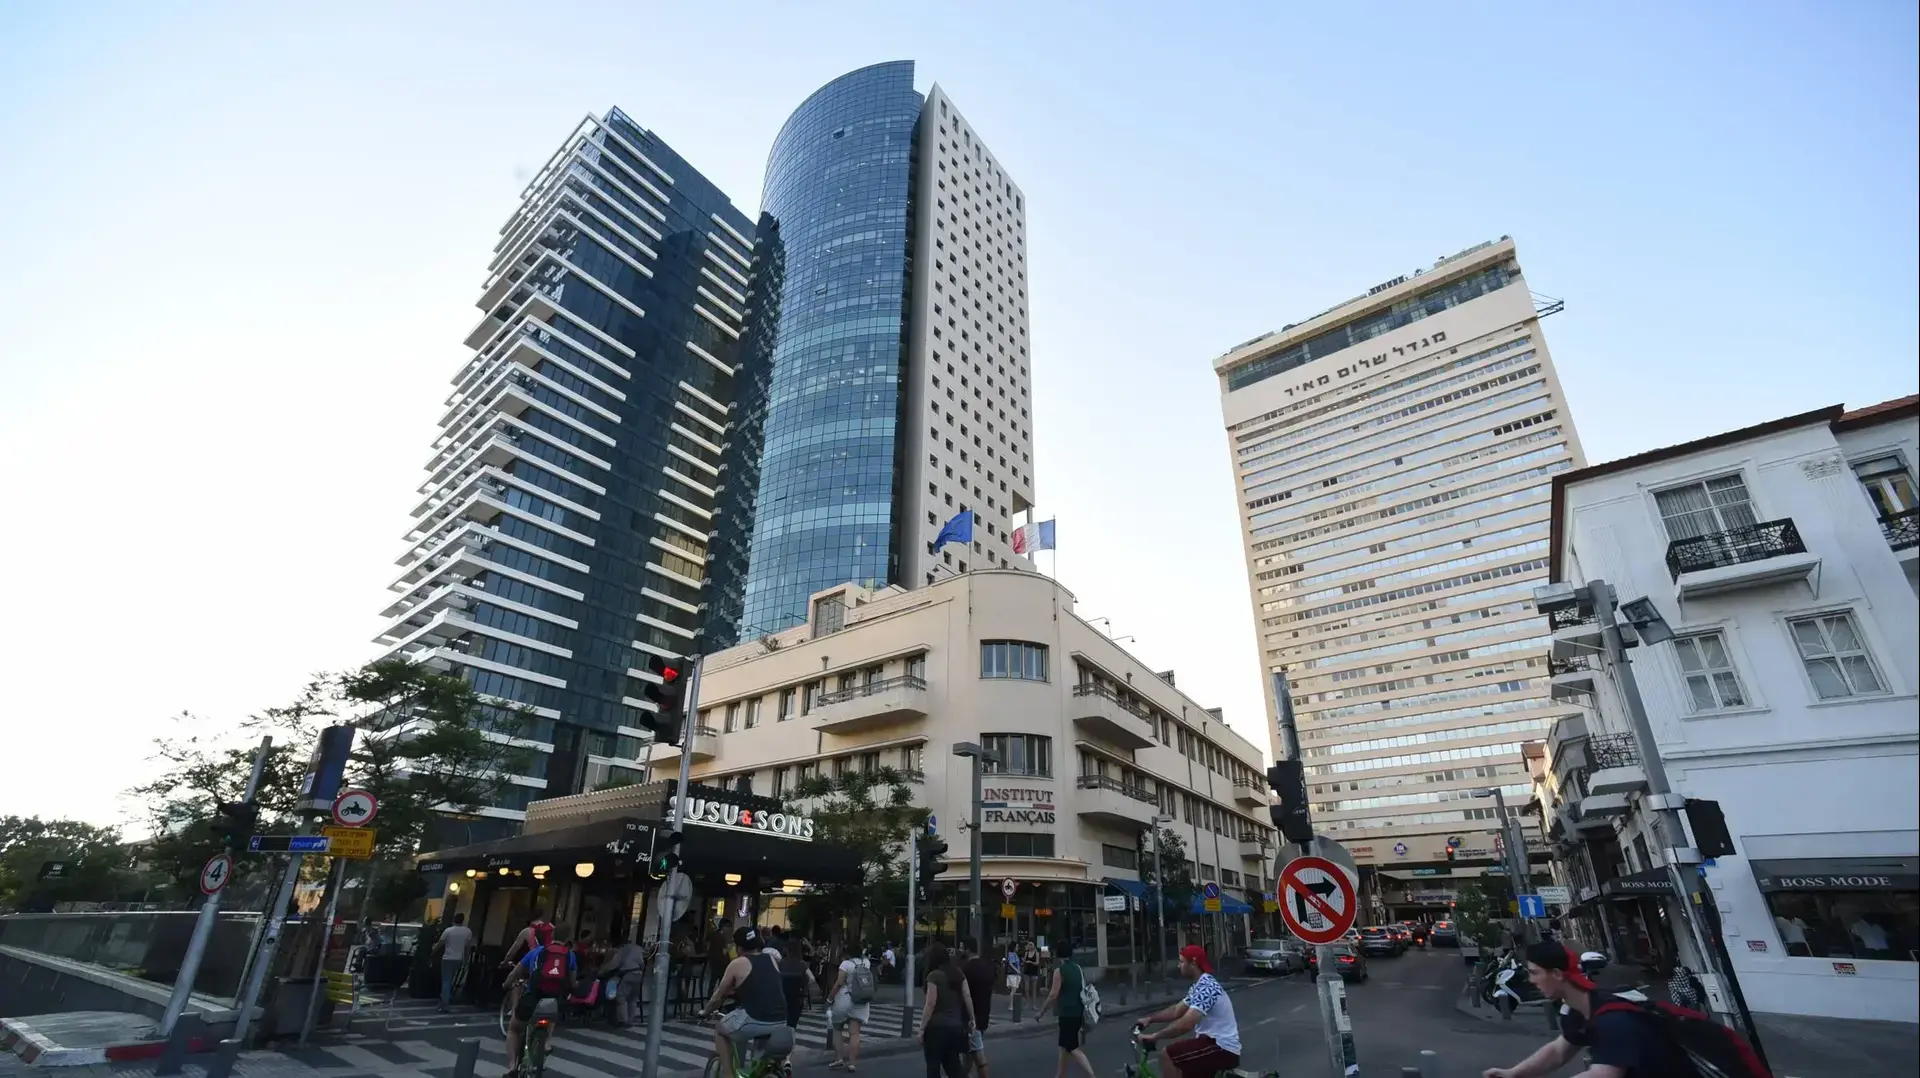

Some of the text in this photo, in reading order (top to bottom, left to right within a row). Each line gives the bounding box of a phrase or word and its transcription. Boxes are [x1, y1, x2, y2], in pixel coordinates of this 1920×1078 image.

[1284, 331, 1447, 397] מגדל שלום מאיר
[984, 788, 1053, 802] INSTITUT
[985, 810, 1055, 826] FRANÇAIS
[210, 862, 223, 882] 4
[1780, 877, 1825, 888] BOSS
[1831, 876, 1892, 887] MODE
